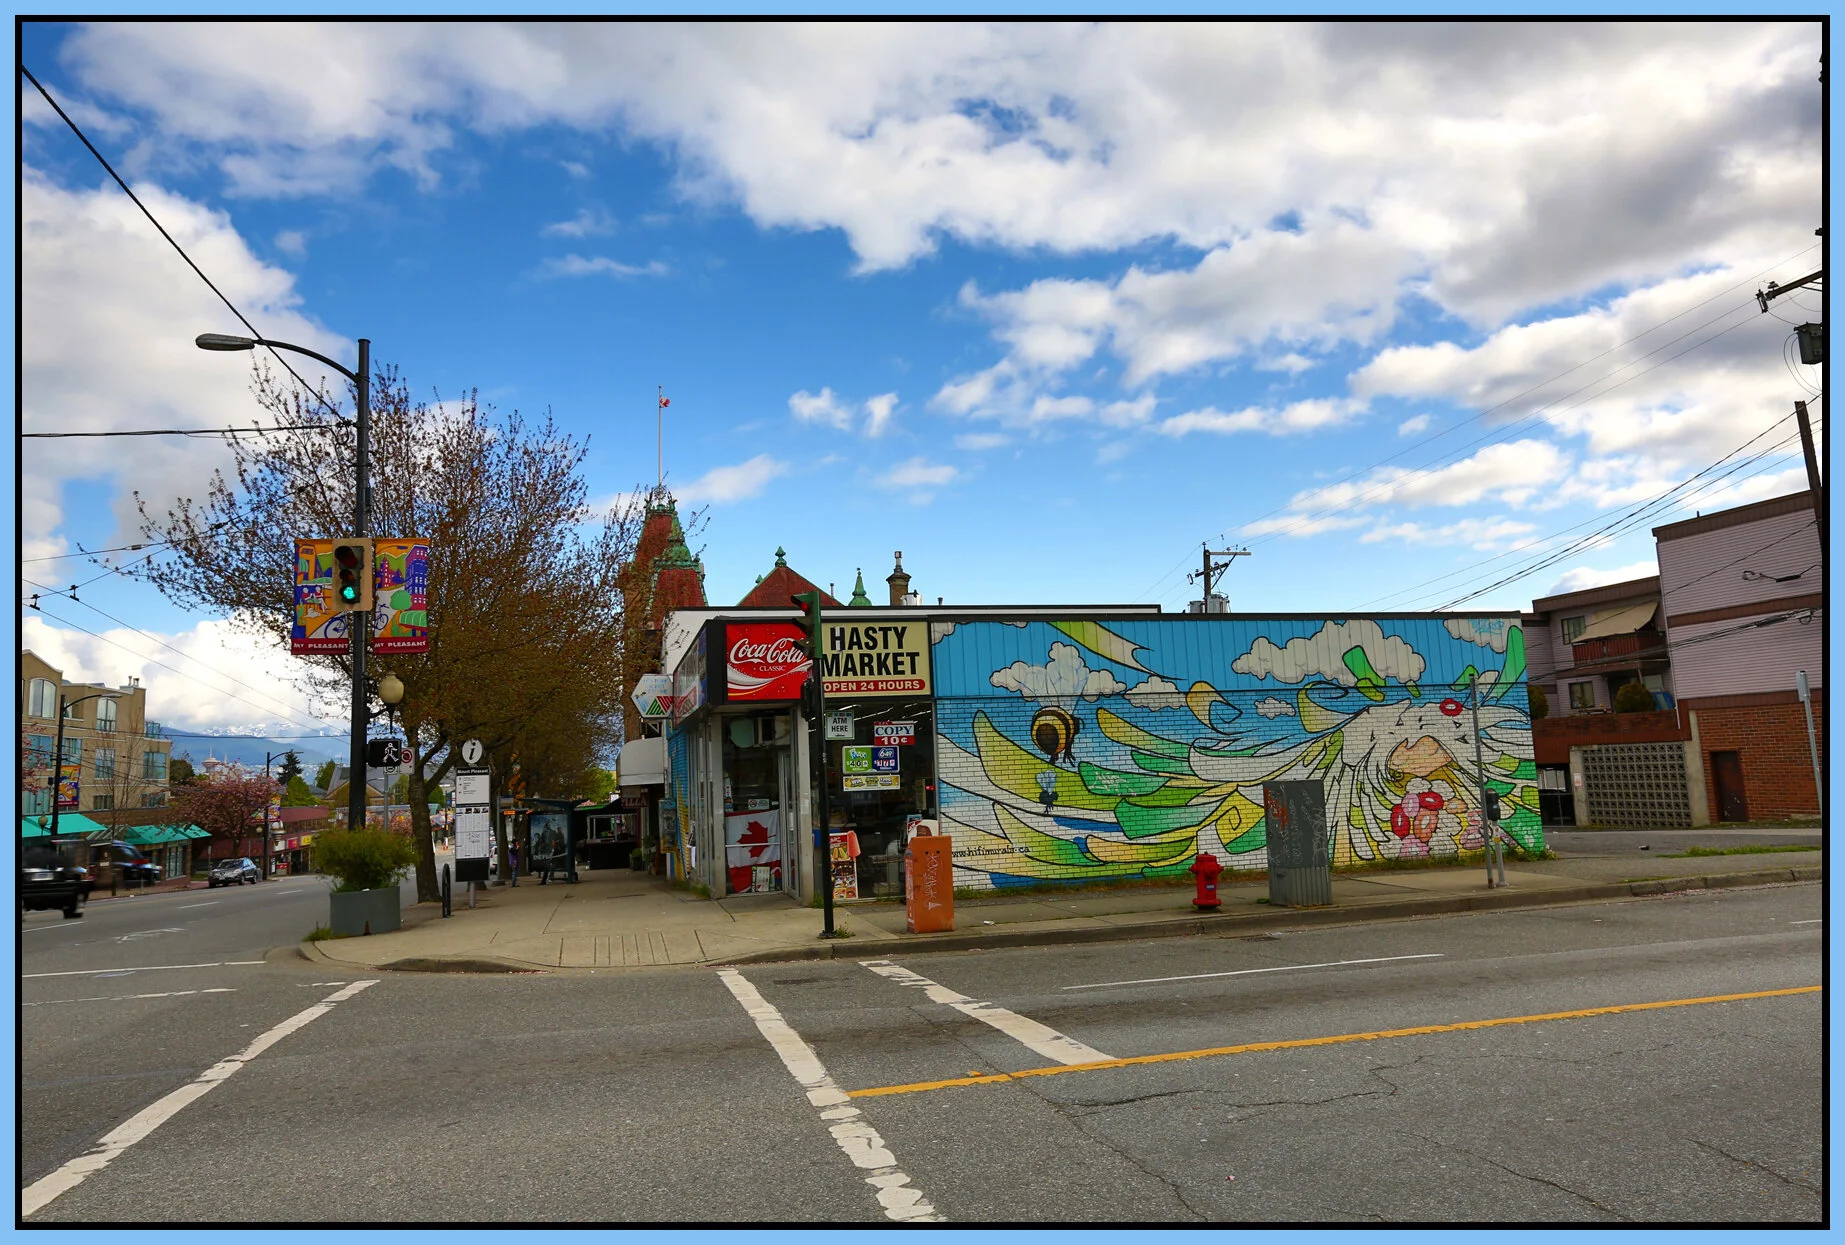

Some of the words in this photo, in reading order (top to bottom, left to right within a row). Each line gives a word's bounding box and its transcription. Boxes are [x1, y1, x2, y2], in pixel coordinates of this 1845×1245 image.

[387, 640, 426, 648] PLEASANT
[830, 626, 907, 651] HASTY
[730, 637, 805, 664] Coca-Cola
[822, 652, 920, 677] MARKET
[823, 683, 857, 692] OPEN
[860, 682, 875, 690] 24
[878, 680, 920, 690] HOURS
[875, 725, 912, 736] COPY
[952, 845, 1031, 857] ww.hifimurals.ca
